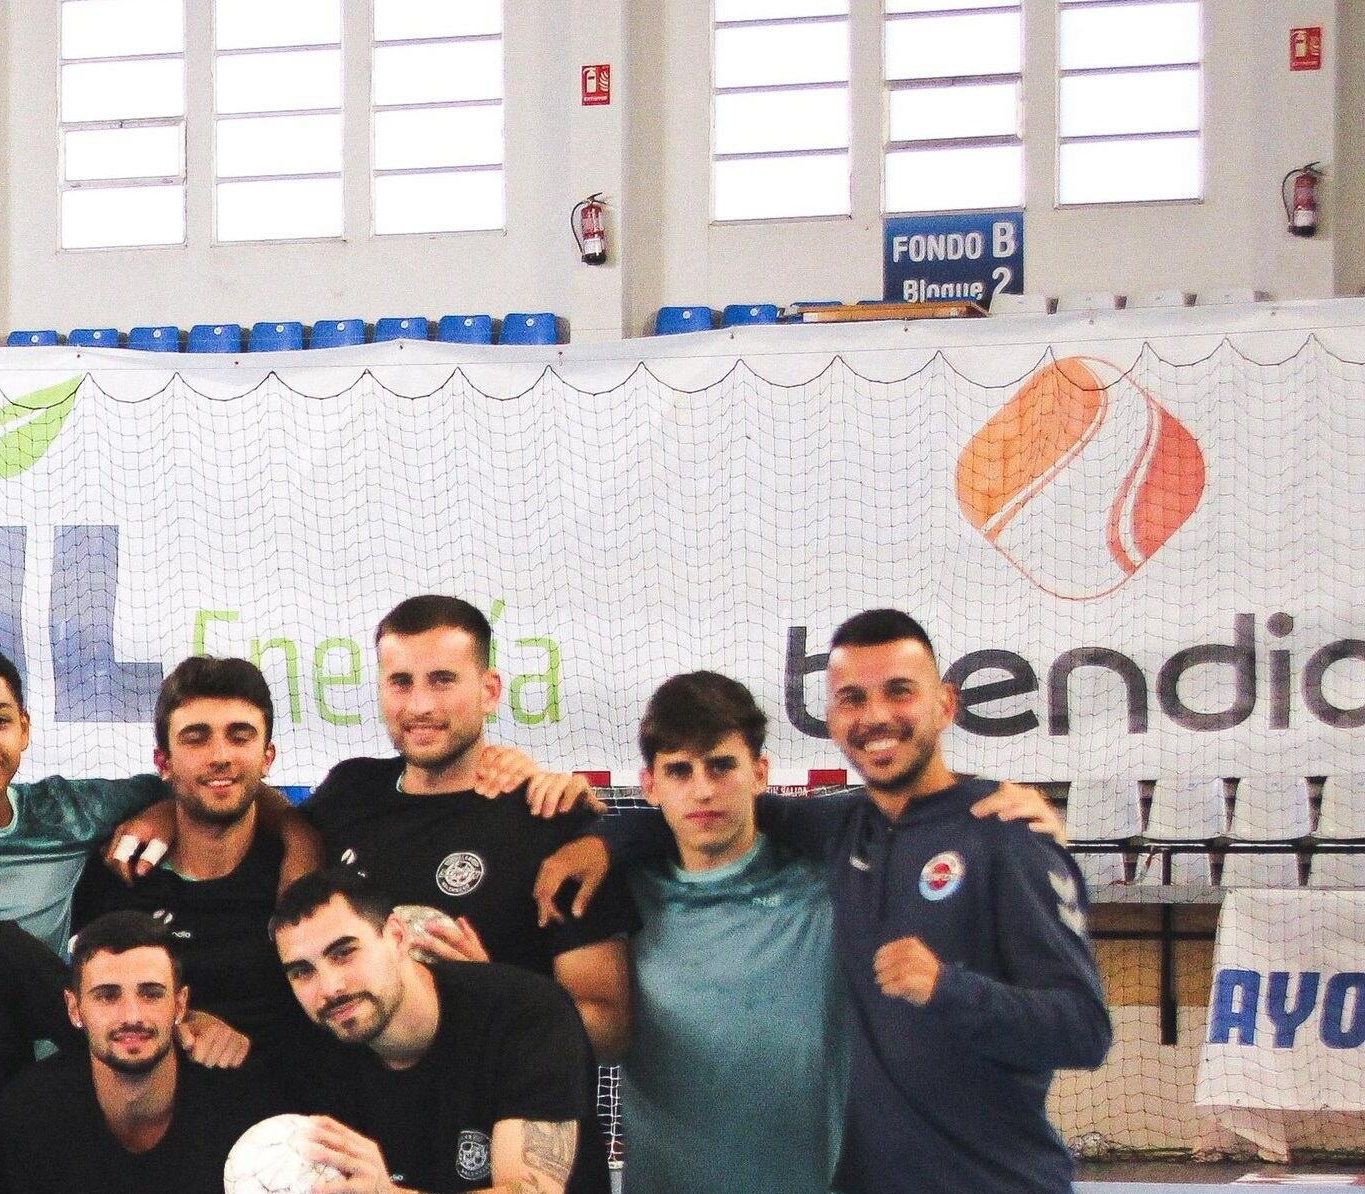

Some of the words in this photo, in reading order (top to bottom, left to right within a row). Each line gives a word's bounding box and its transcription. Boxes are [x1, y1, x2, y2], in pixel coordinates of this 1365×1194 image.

[892, 232, 983, 263] FONDO
[992, 221, 1016, 258] B
[903, 279, 984, 304] Bloque
[988, 266, 1012, 312] 2
[786, 612, 1365, 739] bendio
